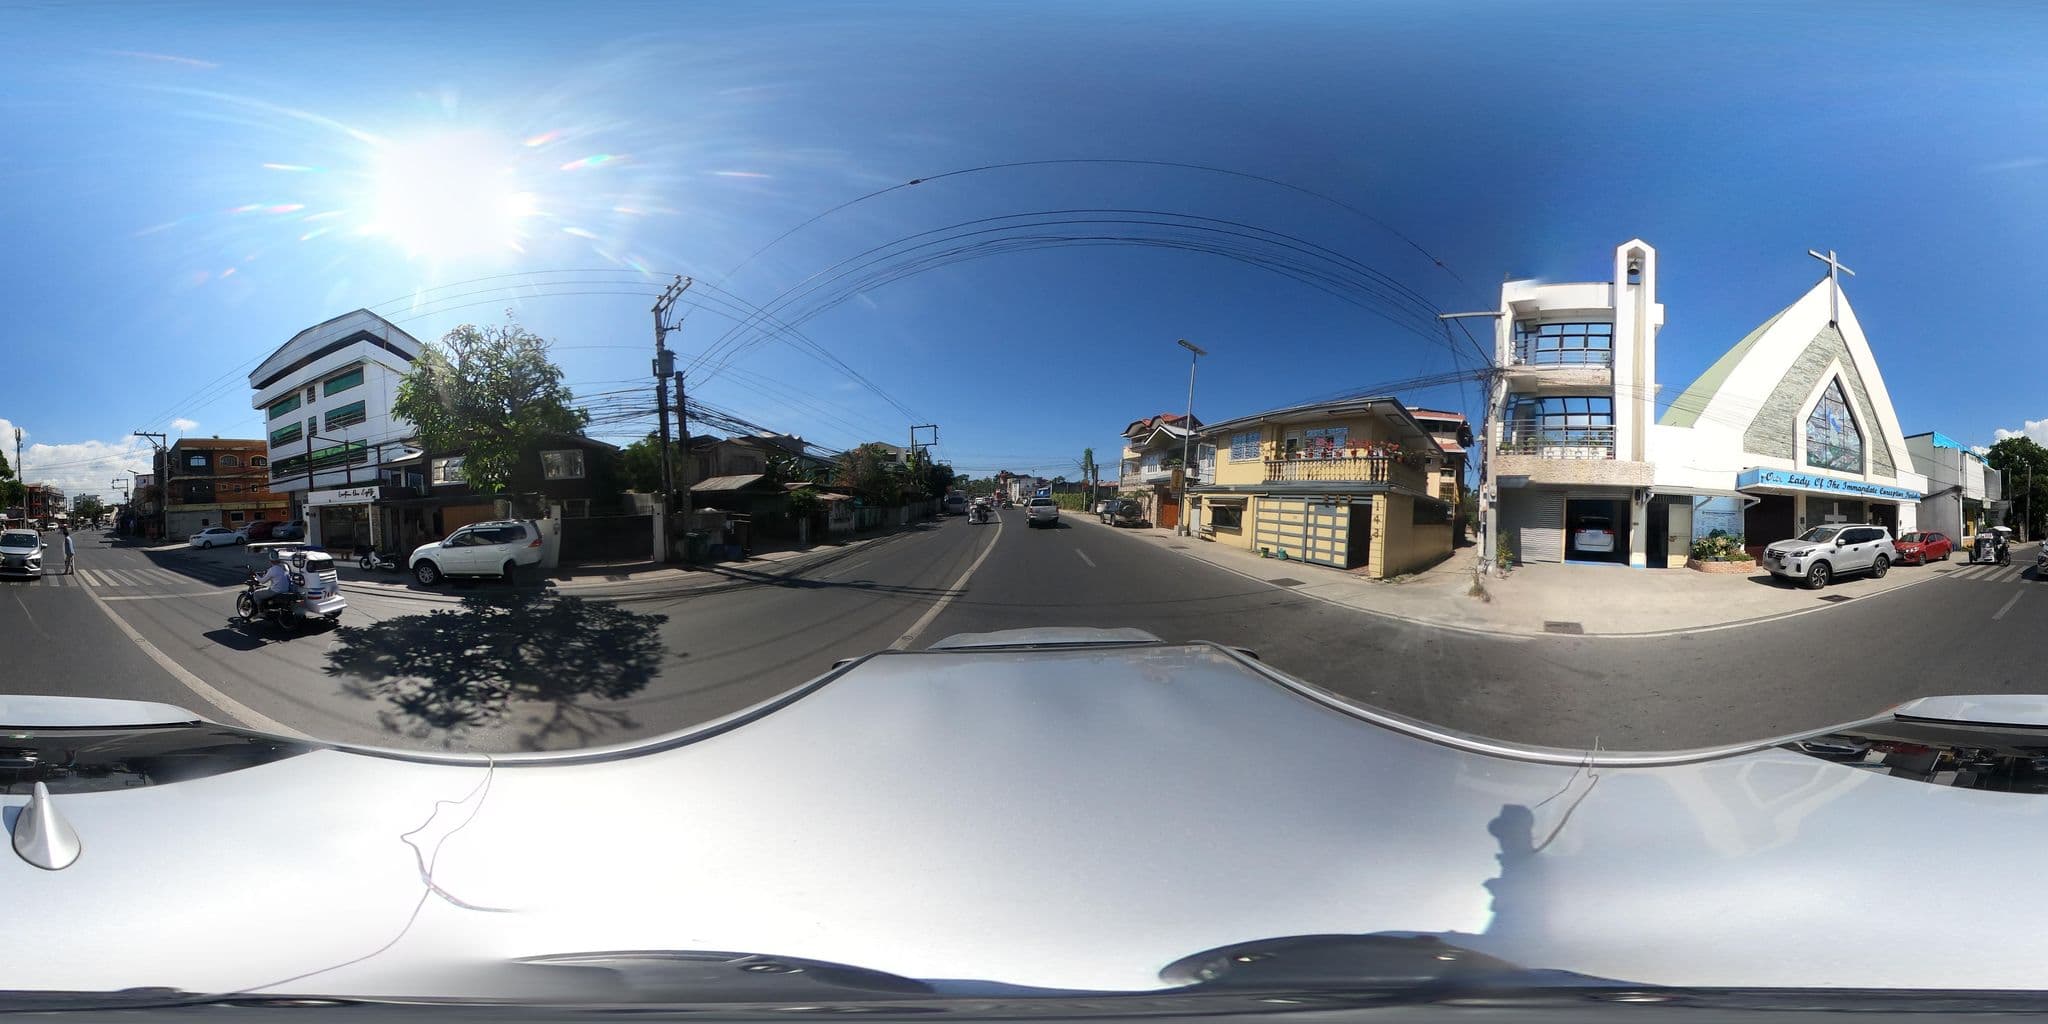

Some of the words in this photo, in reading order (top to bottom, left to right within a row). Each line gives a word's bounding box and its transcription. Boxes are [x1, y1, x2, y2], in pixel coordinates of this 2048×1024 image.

[1788, 474, 1811, 488] Lady
[1814, 477, 1824, 489] Of
[1826, 479, 1840, 490] The
